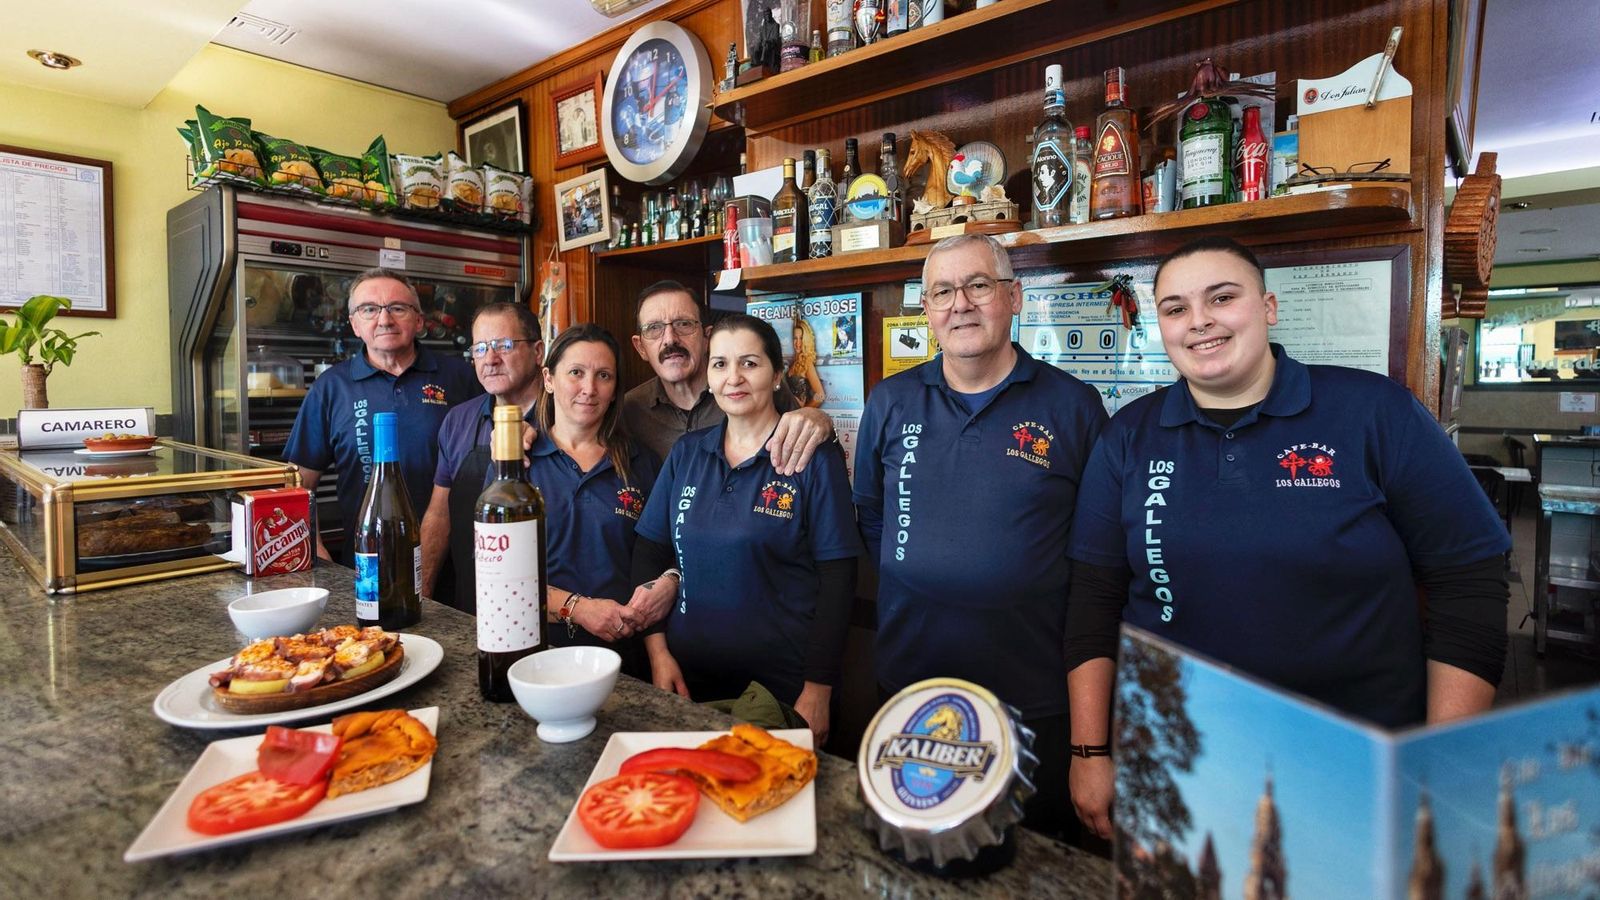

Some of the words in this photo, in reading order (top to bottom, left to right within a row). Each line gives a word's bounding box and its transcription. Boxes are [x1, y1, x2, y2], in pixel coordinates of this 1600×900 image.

[1235, 138, 1267, 160] Coca
[1097, 153, 1124, 163] CACIQUE
[34, 163, 69, 172] PRECIOS
[751, 302, 820, 320] RECAMOS
[823, 299, 857, 315] JOSE
[1070, 333, 1078, 346] 0
[1103, 334, 1111, 347] 0
[353, 399, 368, 410] LOS
[41, 418, 137, 433] CAMARERO
[902, 424, 922, 434] LOS
[1012, 421, 1055, 441] CAFE-BAR
[844, 433, 850, 443] 2
[1006, 448, 1019, 457] LOS
[1019, 450, 1051, 469] GALLEGOS
[1276, 442, 1337, 460] CAFE-BAR
[1149, 460, 1175, 475] LOS
[1276, 479, 1293, 488] LOS
[1294, 478, 1341, 489] GALLEGOS
[895, 435, 919, 561] GALLEGOS
[753, 505, 765, 514] LOS
[765, 508, 794, 519] GALLEGOS
[256, 522, 308, 569] Cruzcampo
[1144, 476, 1174, 623] GALLEGOS
[887, 738, 984, 767] KALIBER
